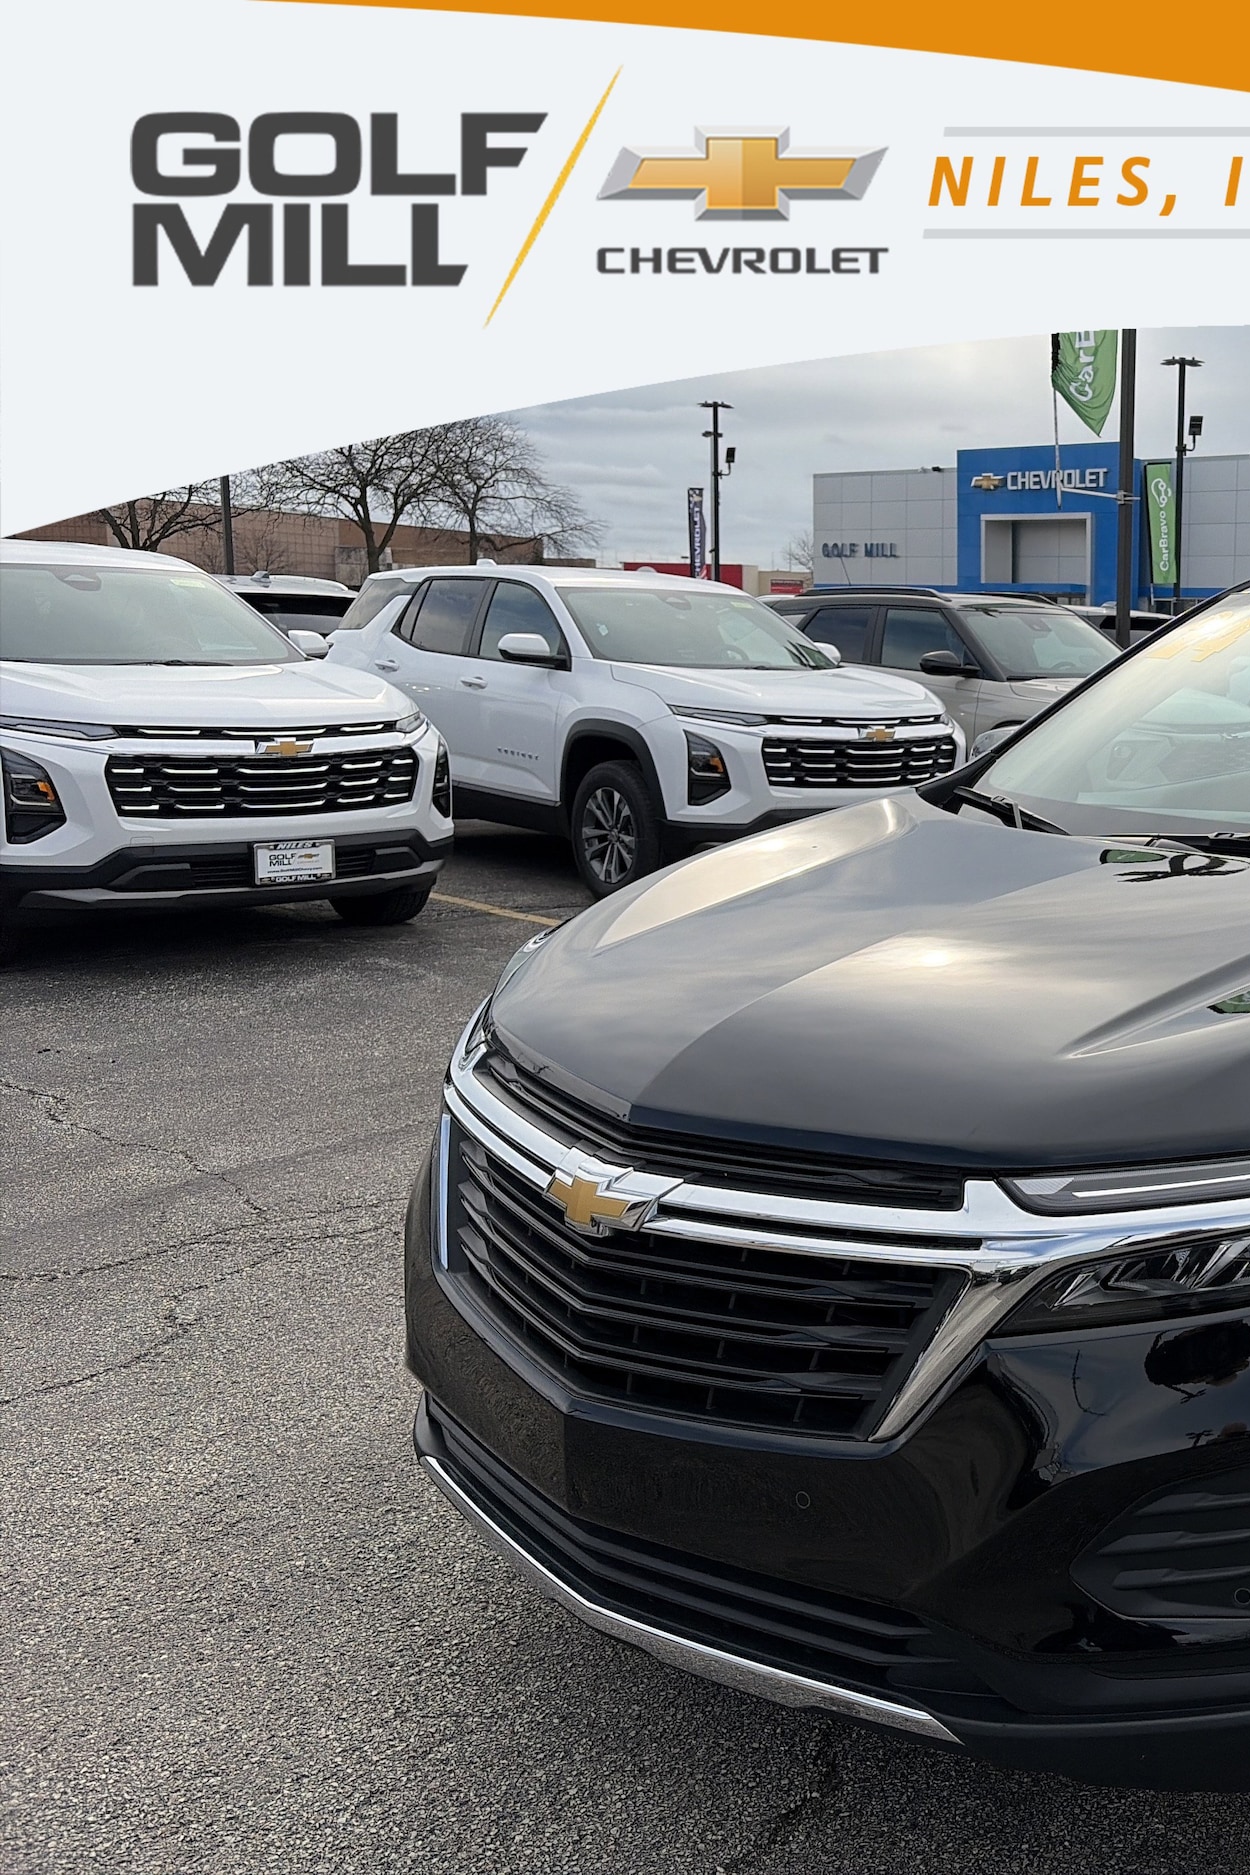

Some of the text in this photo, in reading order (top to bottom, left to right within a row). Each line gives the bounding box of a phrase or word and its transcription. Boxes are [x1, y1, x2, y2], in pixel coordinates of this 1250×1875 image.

[1007, 467, 1108, 491] CHEVROLET
[822, 542, 900, 558] GOLF MILL
[1159, 511, 1169, 571] CarBravo
[269, 859, 292, 867] MILL
